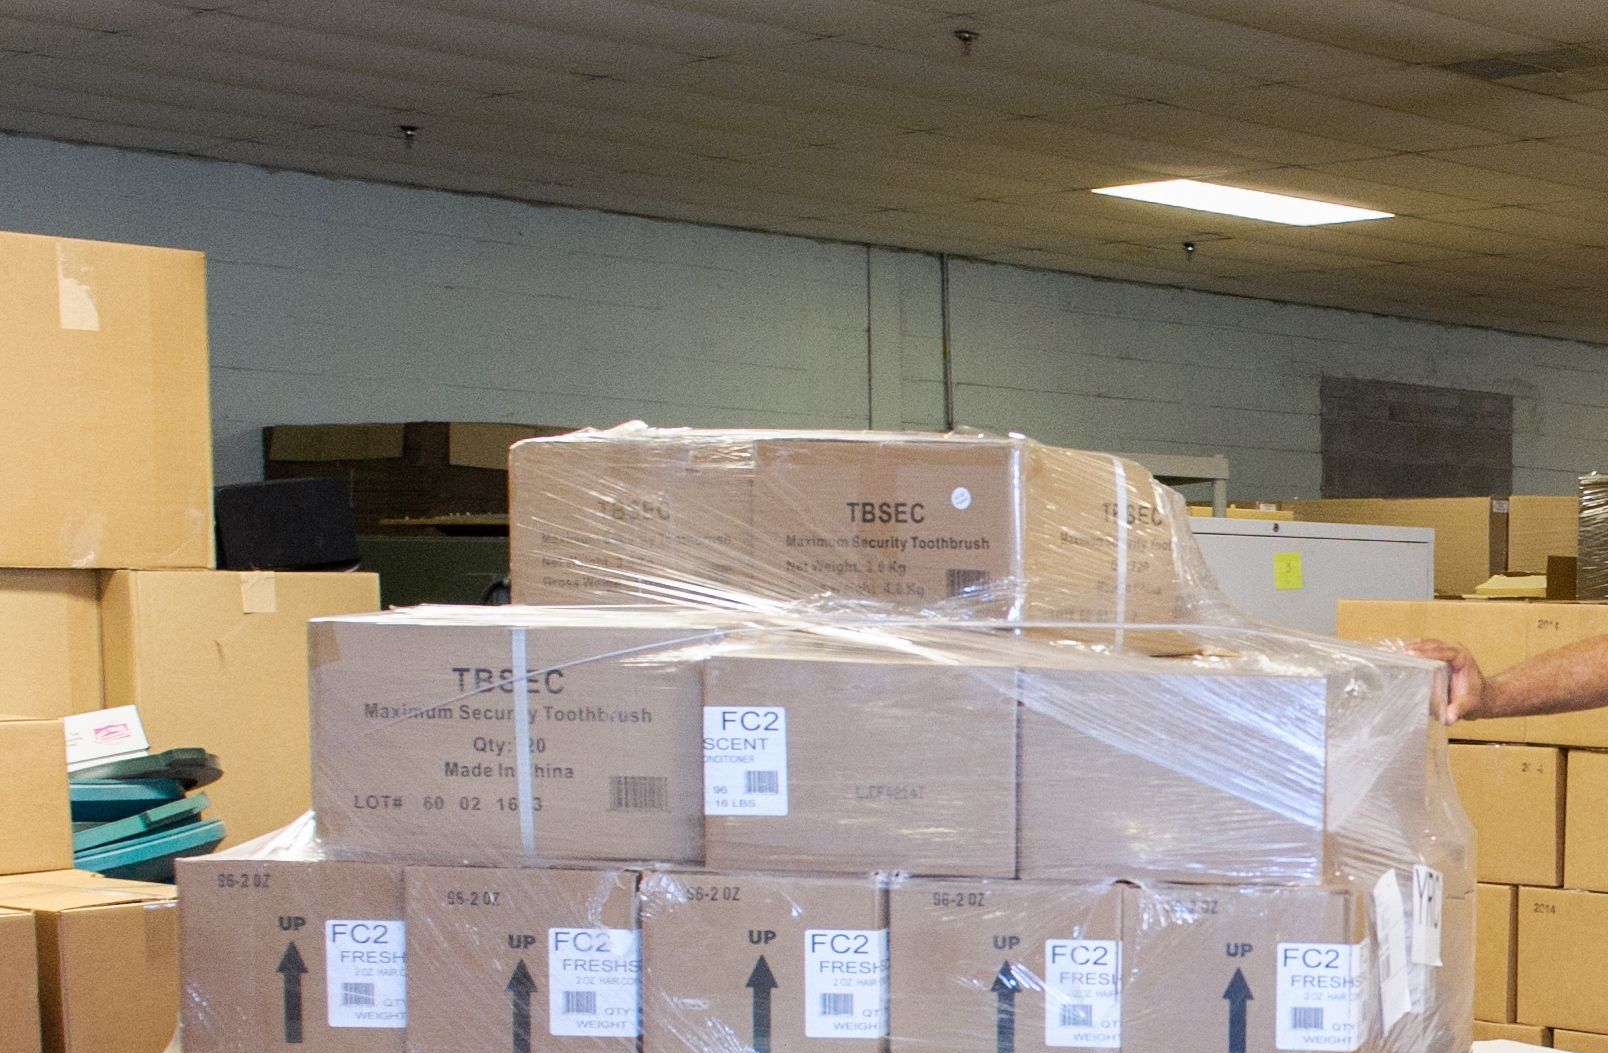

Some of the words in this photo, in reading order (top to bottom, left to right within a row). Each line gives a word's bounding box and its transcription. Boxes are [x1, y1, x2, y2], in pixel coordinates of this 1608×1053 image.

[846, 502, 925, 523] TBSEC
[785, 535, 849, 548] Maximum
[852, 535, 907, 551] Security
[911, 535, 989, 551] Toothbrush
[364, 702, 453, 721] Maximum
[459, 703, 536, 725] Secury
[543, 704, 652, 723] Toothbrush
[721, 710, 780, 732] FC2
[703, 737, 769, 751] SCENT
[444, 761, 493, 778] Made
[498, 762, 515, 778] In
[534, 762, 575, 779] hina
[713, 785, 728, 794] 96
[353, 794, 403, 810] LOT#
[423, 796, 444, 811] 60
[459, 796, 481, 811] 02
[715, 799, 729, 808] 16
[278, 916, 306, 931] UP
[331, 923, 388, 944] FC2
[508, 934, 536, 949] UP
[554, 931, 611, 952] FC2
[748, 929, 777, 945] UP
[811, 933, 869, 954] FC2
[993, 935, 1021, 951] UP
[1226, 942, 1254, 958] UP
[1052, 945, 1108, 965] FC2
[1283, 948, 1340, 969] FC2
[576, 1020, 626, 1029] WEIGHT
